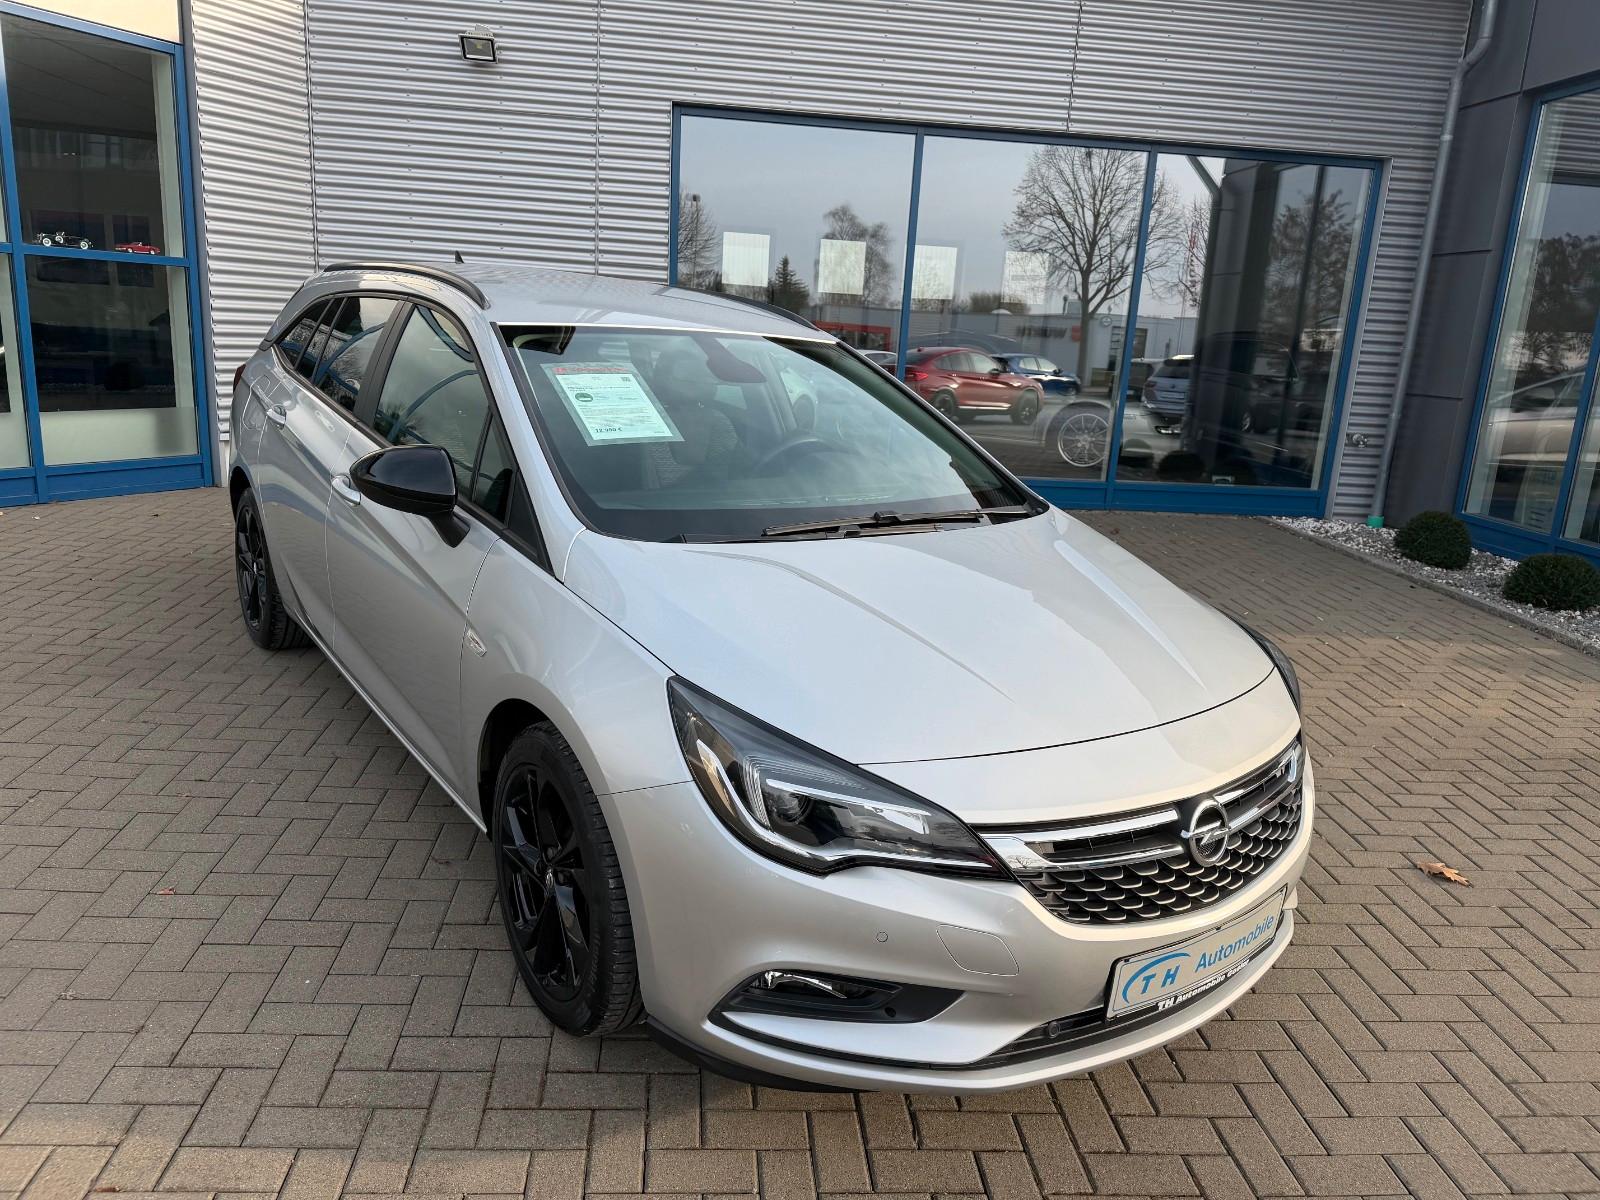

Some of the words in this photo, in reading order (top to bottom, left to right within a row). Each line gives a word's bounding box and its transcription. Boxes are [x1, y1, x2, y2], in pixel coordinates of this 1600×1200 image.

[1194, 915, 1275, 973] Automobile
[1157, 996, 1176, 1011] TH
[1175, 974, 1226, 1005] Automobile
